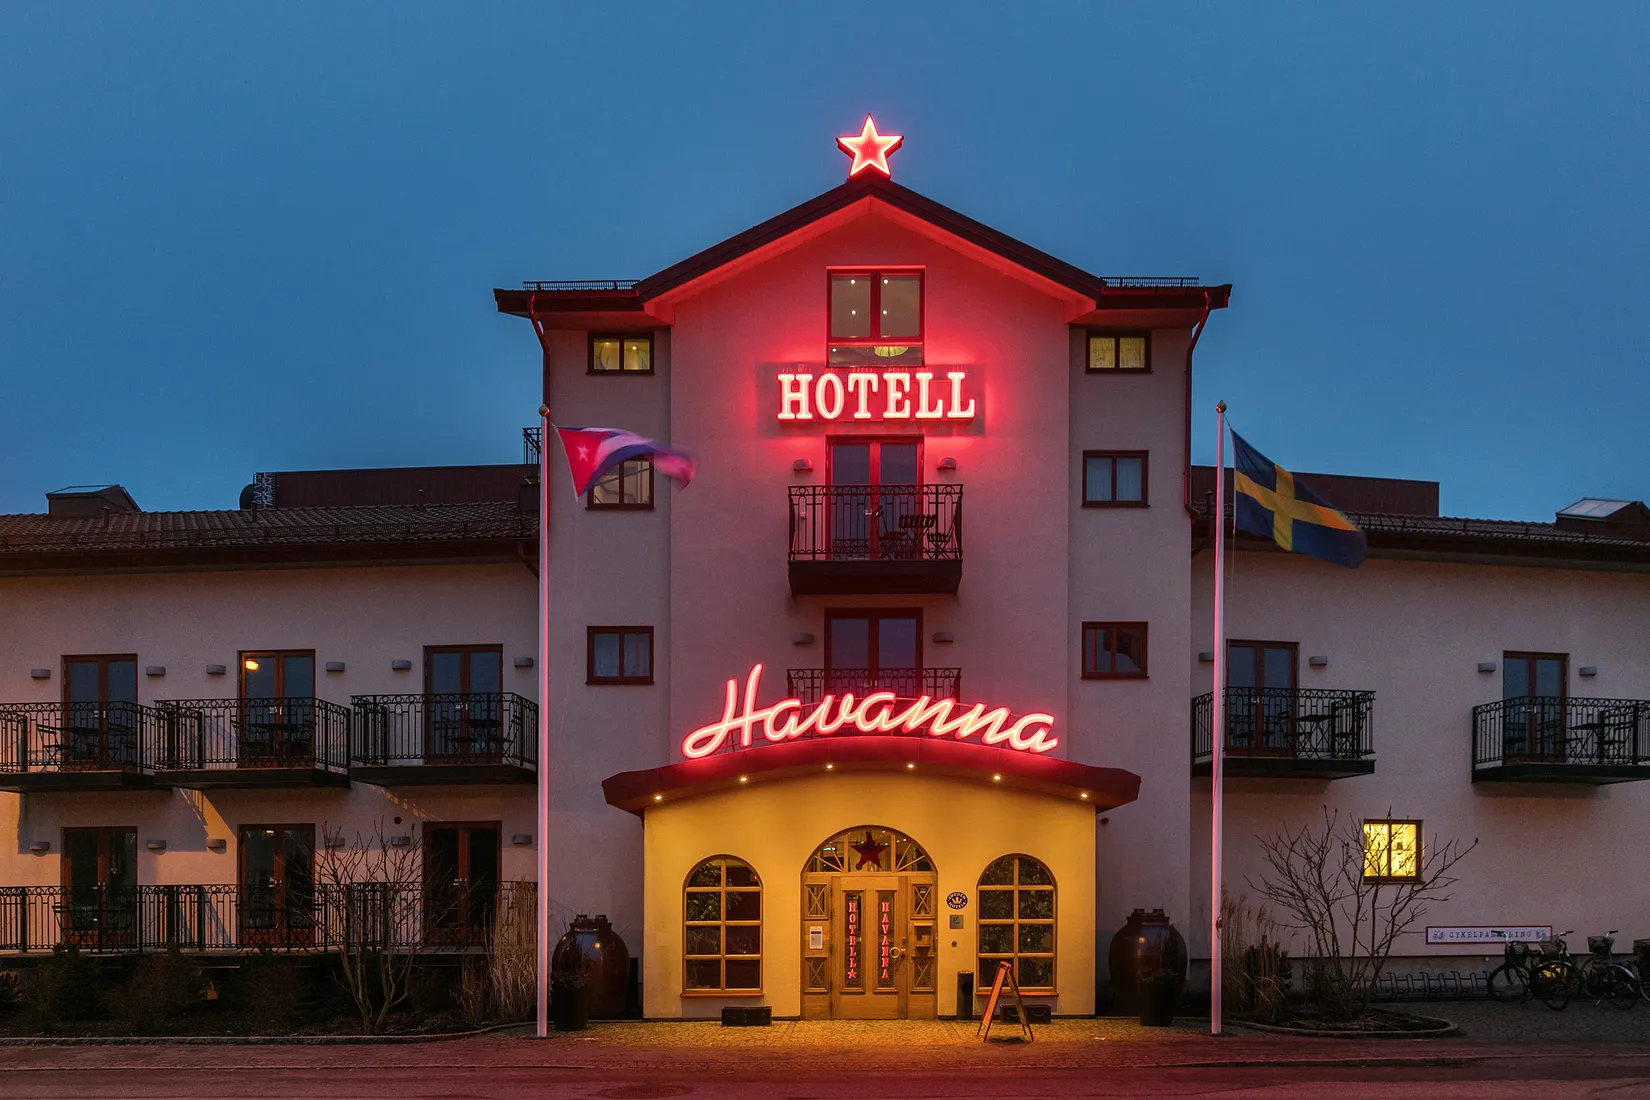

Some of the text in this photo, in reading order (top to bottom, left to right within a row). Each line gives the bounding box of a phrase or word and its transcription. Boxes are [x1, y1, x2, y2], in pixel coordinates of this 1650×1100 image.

[777, 372, 976, 420] HOTELL
[681, 663, 1060, 759] Havanna
[848, 902, 857, 968] HOTELL
[881, 902, 889, 979] HAVANNA
[1448, 931, 1532, 939] CYKELPARRING
